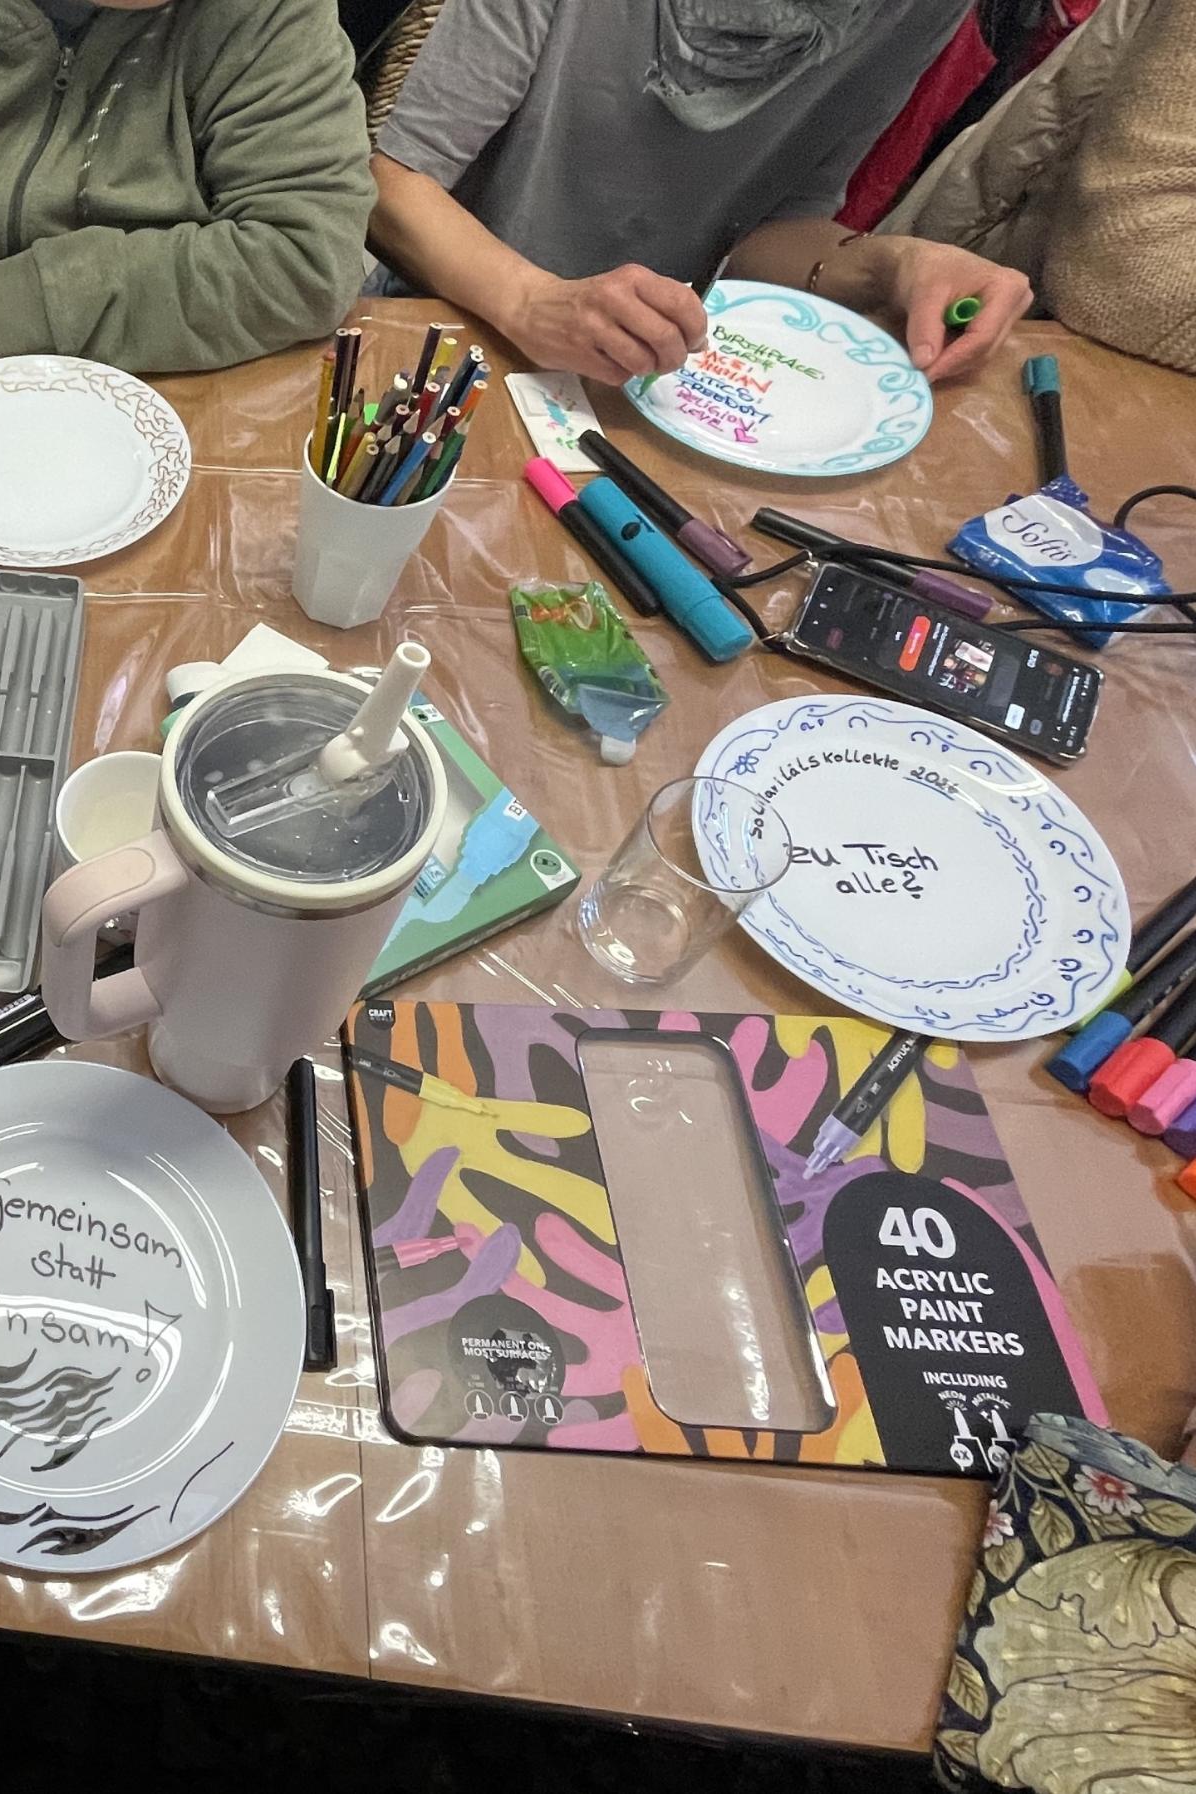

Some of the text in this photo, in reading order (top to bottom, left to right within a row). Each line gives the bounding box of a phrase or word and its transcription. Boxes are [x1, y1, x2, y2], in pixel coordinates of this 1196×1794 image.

[1001, 514, 1077, 561] Softis
[842, 843, 938, 871] Tisch
[368, 1009, 393, 1017] CRAFT
[878, 1207, 956, 1259] 40
[876, 1267, 995, 1295] ACRYLIC
[899, 1297, 984, 1323] PAINT
[461, 1337, 526, 1350] PERMANENT
[464, 1347, 495, 1357] MOST
[882, 1326, 1025, 1356] MARKERS
[923, 1371, 1008, 1389] INCLUDING
[937, 1390, 967, 1401] NEON
[971, 1392, 1012, 1410] METALLIC
